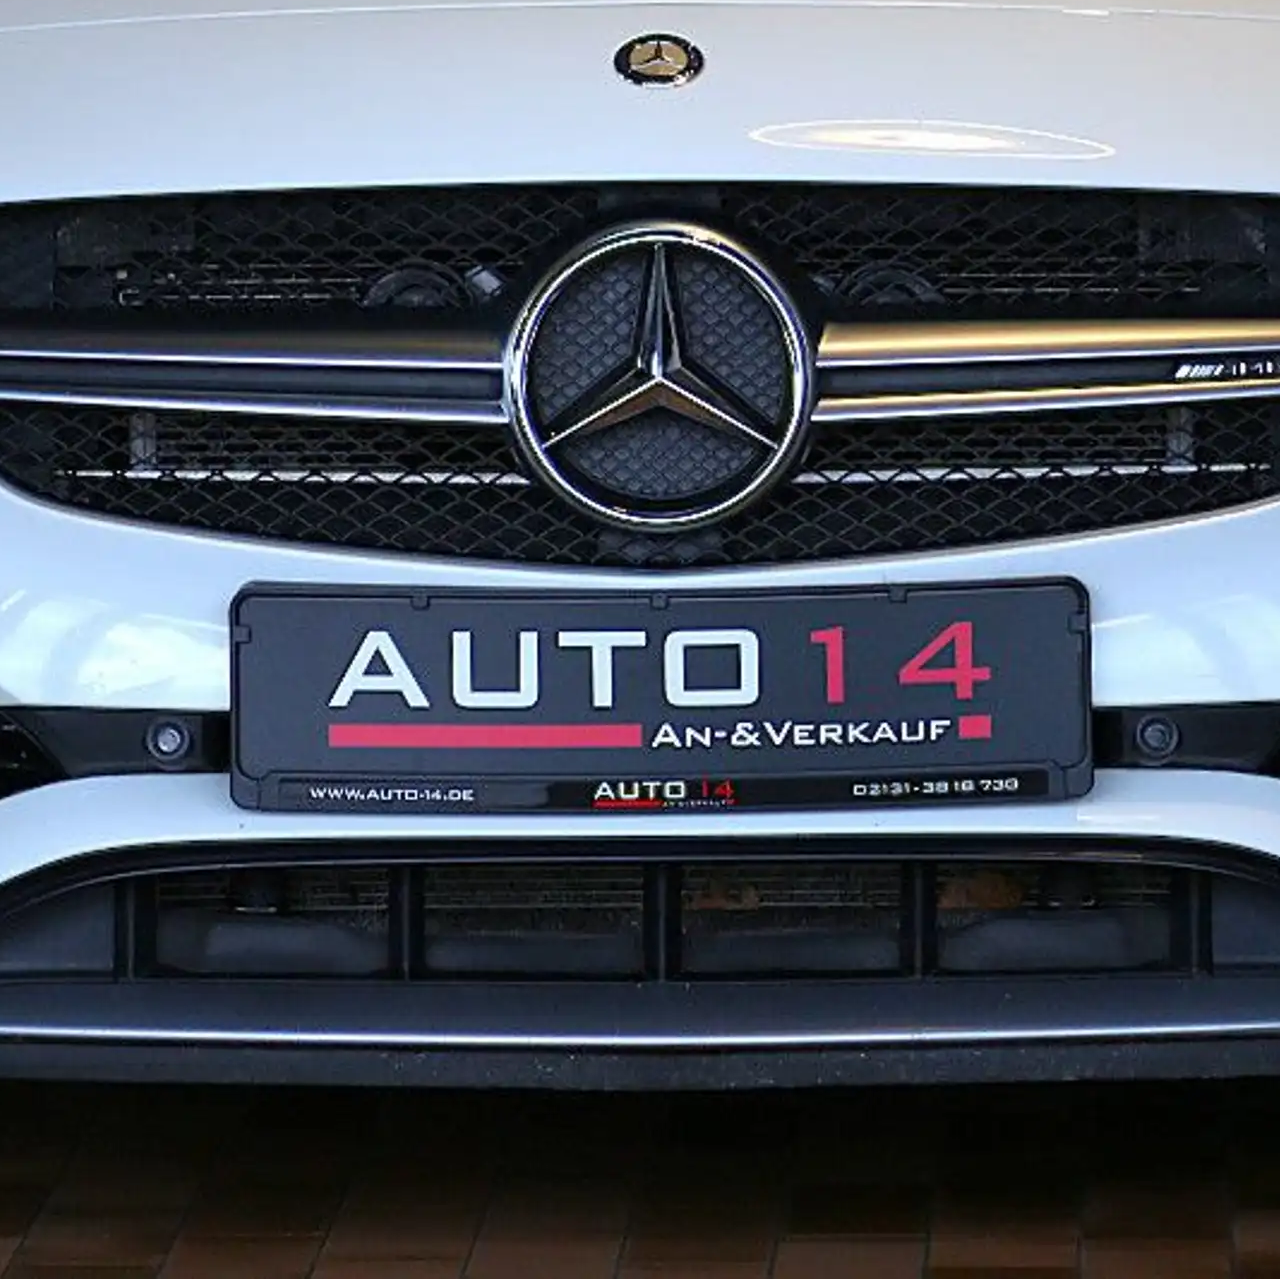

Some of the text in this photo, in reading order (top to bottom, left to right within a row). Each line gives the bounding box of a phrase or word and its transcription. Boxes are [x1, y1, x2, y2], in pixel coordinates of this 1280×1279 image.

[328, 620, 992, 709] AUTO 14
[593, 776, 735, 801] AUTO 14
